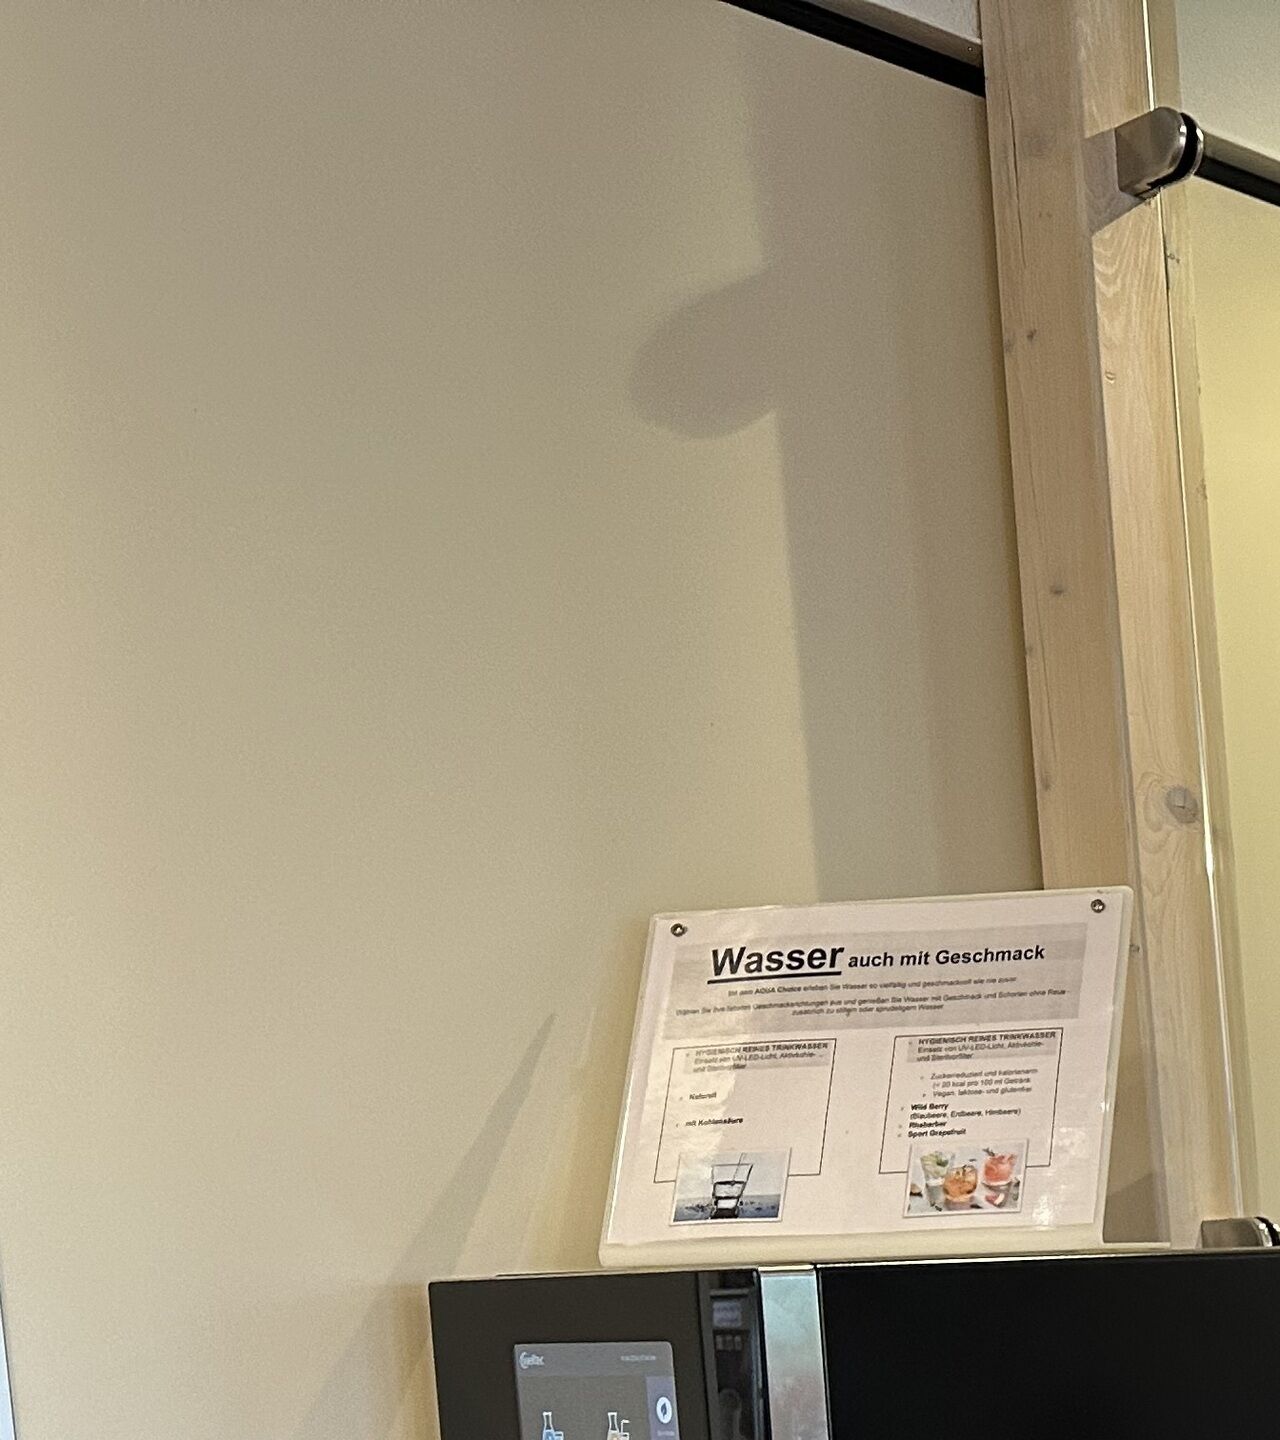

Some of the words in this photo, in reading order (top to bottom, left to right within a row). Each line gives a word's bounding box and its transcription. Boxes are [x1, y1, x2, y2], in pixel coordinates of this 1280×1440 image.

[711, 946, 845, 977] Wasser
[848, 952, 894, 968] auch
[900, 950, 930, 966] mit
[935, 945, 1046, 964] Geschmack
